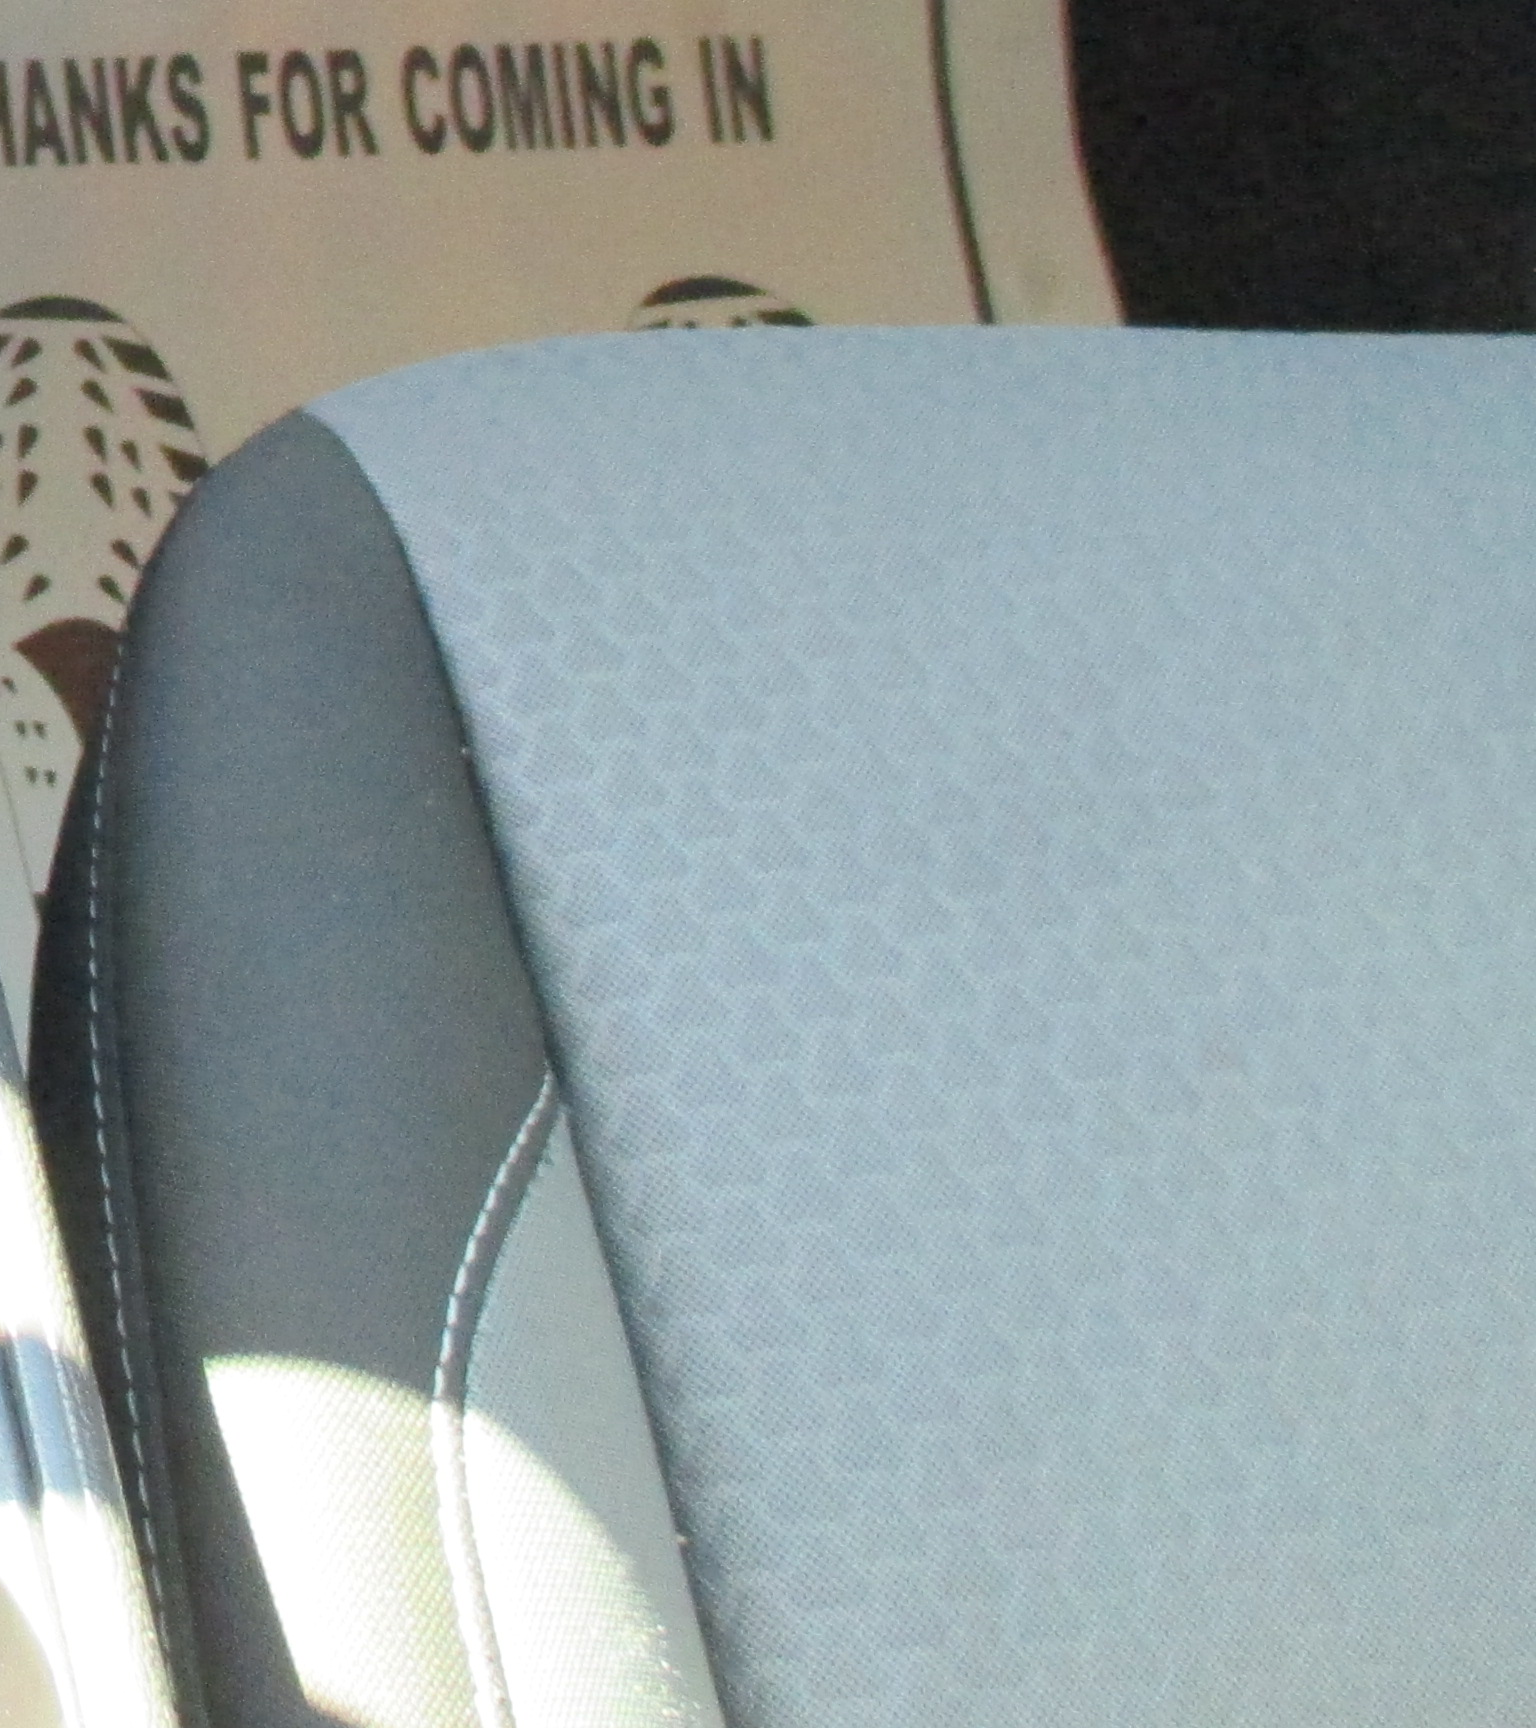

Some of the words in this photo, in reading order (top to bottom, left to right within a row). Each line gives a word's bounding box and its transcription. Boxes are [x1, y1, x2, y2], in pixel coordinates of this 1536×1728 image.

[237, 46, 380, 161] FOR
[402, 39, 675, 155] COMING
[697, 33, 776, 144] IN
